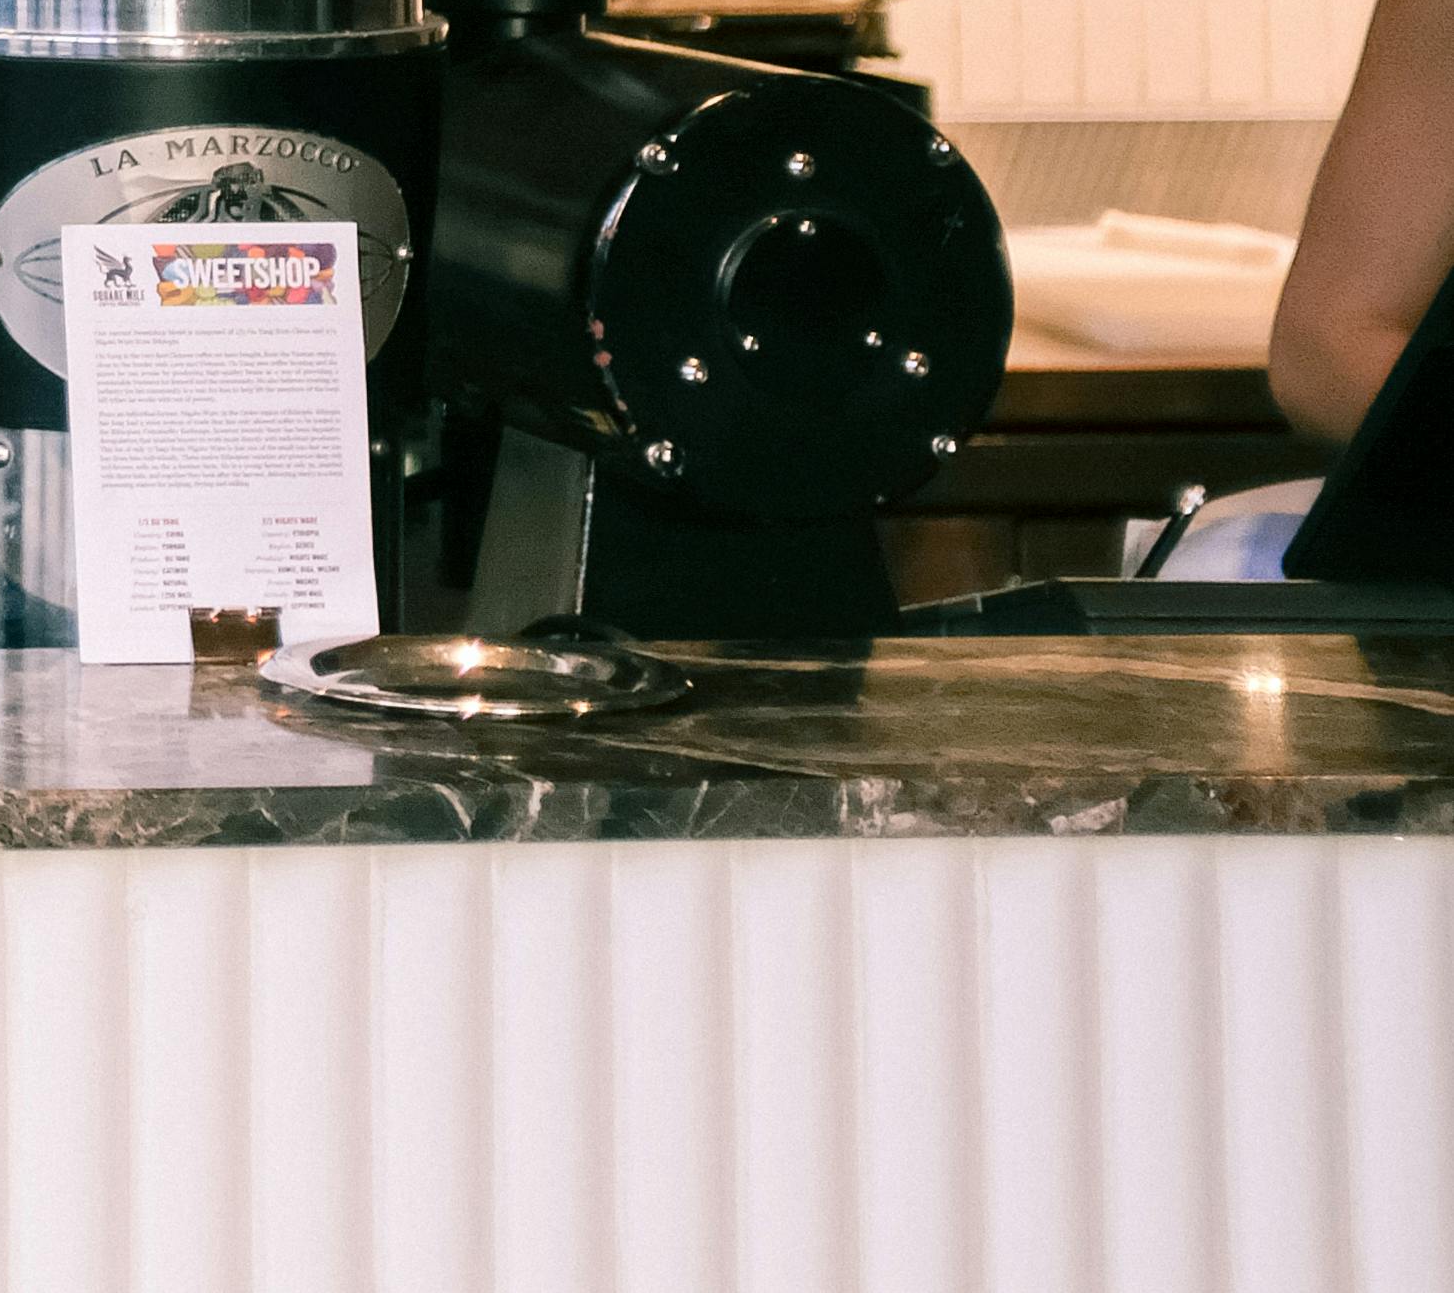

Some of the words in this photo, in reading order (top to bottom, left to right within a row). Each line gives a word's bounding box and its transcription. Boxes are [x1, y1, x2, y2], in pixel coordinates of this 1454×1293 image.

[89, 148, 141, 178] LA
[165, 134, 355, 174] MARZOCCO
[172, 257, 322, 290] SWEETSHOP
